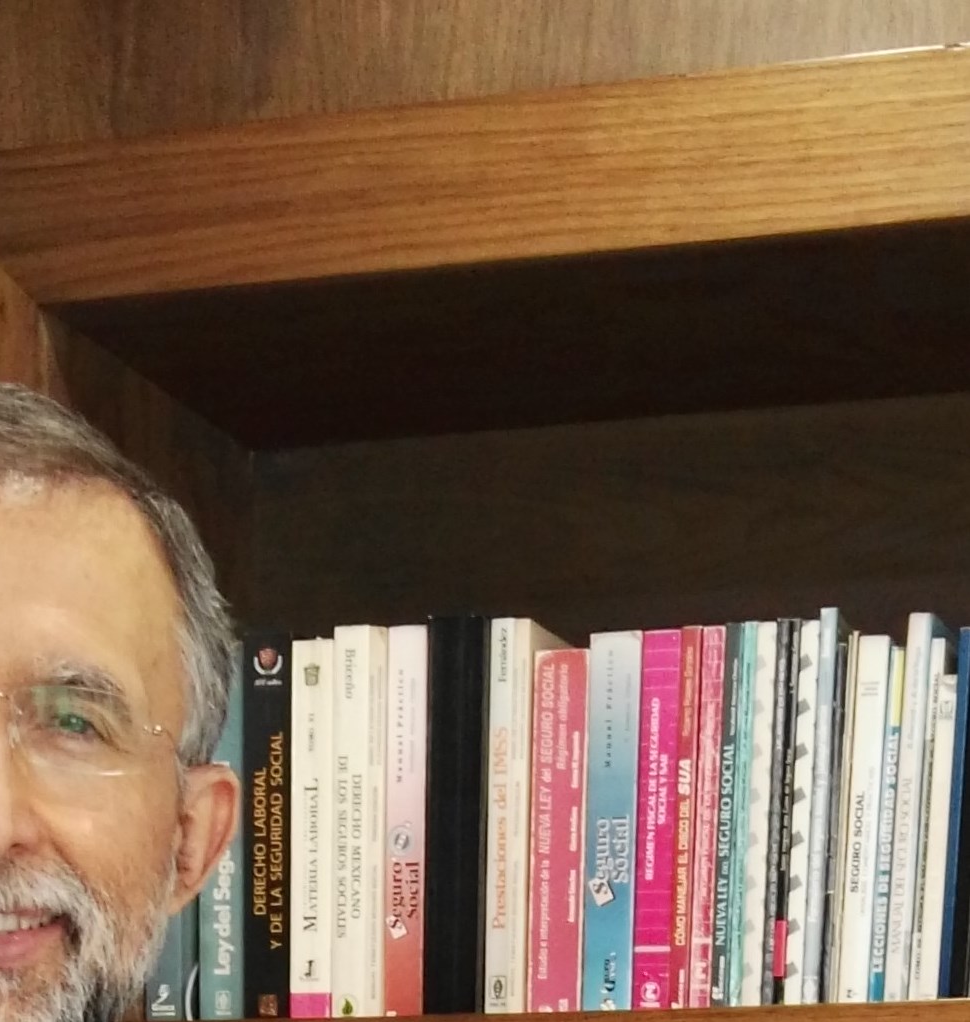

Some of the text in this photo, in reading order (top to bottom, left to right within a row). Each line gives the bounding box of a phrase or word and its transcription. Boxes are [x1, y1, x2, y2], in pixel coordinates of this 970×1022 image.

[343, 648, 356, 700] Briceño
[542, 663, 555, 709] SOCIAL
[557, 663, 570, 721] obligatorio
[540, 711, 554, 764] SEGURO
[539, 786, 552, 811] LEY
[542, 768, 552, 783] del
[647, 777, 658, 793] DE
[721, 743, 736, 796] SOCIAL
[252, 767, 267, 915] DERECHO LABORAL
[270, 731, 284, 950] Y DE LA SEGURIDAD SOCIAL
[336, 756, 348, 939] DE LOS SEGUROS SOCIALES
[349, 774, 362, 920] DERECHO MEXICANO
[492, 727, 509, 930] Prestaciones del IMSS
[538, 813, 551, 855] NUEVA
[611, 814, 629, 883] Social
[673, 758, 692, 946] CÓMO MANEJAR EL DISCO DEL SUA
[719, 797, 733, 857] SEGURO
[850, 791, 866, 893] SEGURO SOCIAL
[871, 732, 900, 973] LECCIONES DE SEGURIDAD SOCIAL
[592, 818, 613, 895] Seguro
[388, 861, 406, 930] Seguro
[404, 861, 420, 920] Social
[717, 877, 729, 898] LEY
[213, 904, 232, 937] del
[715, 898, 728, 946] NUEVA
[213, 938, 236, 976] Ley
